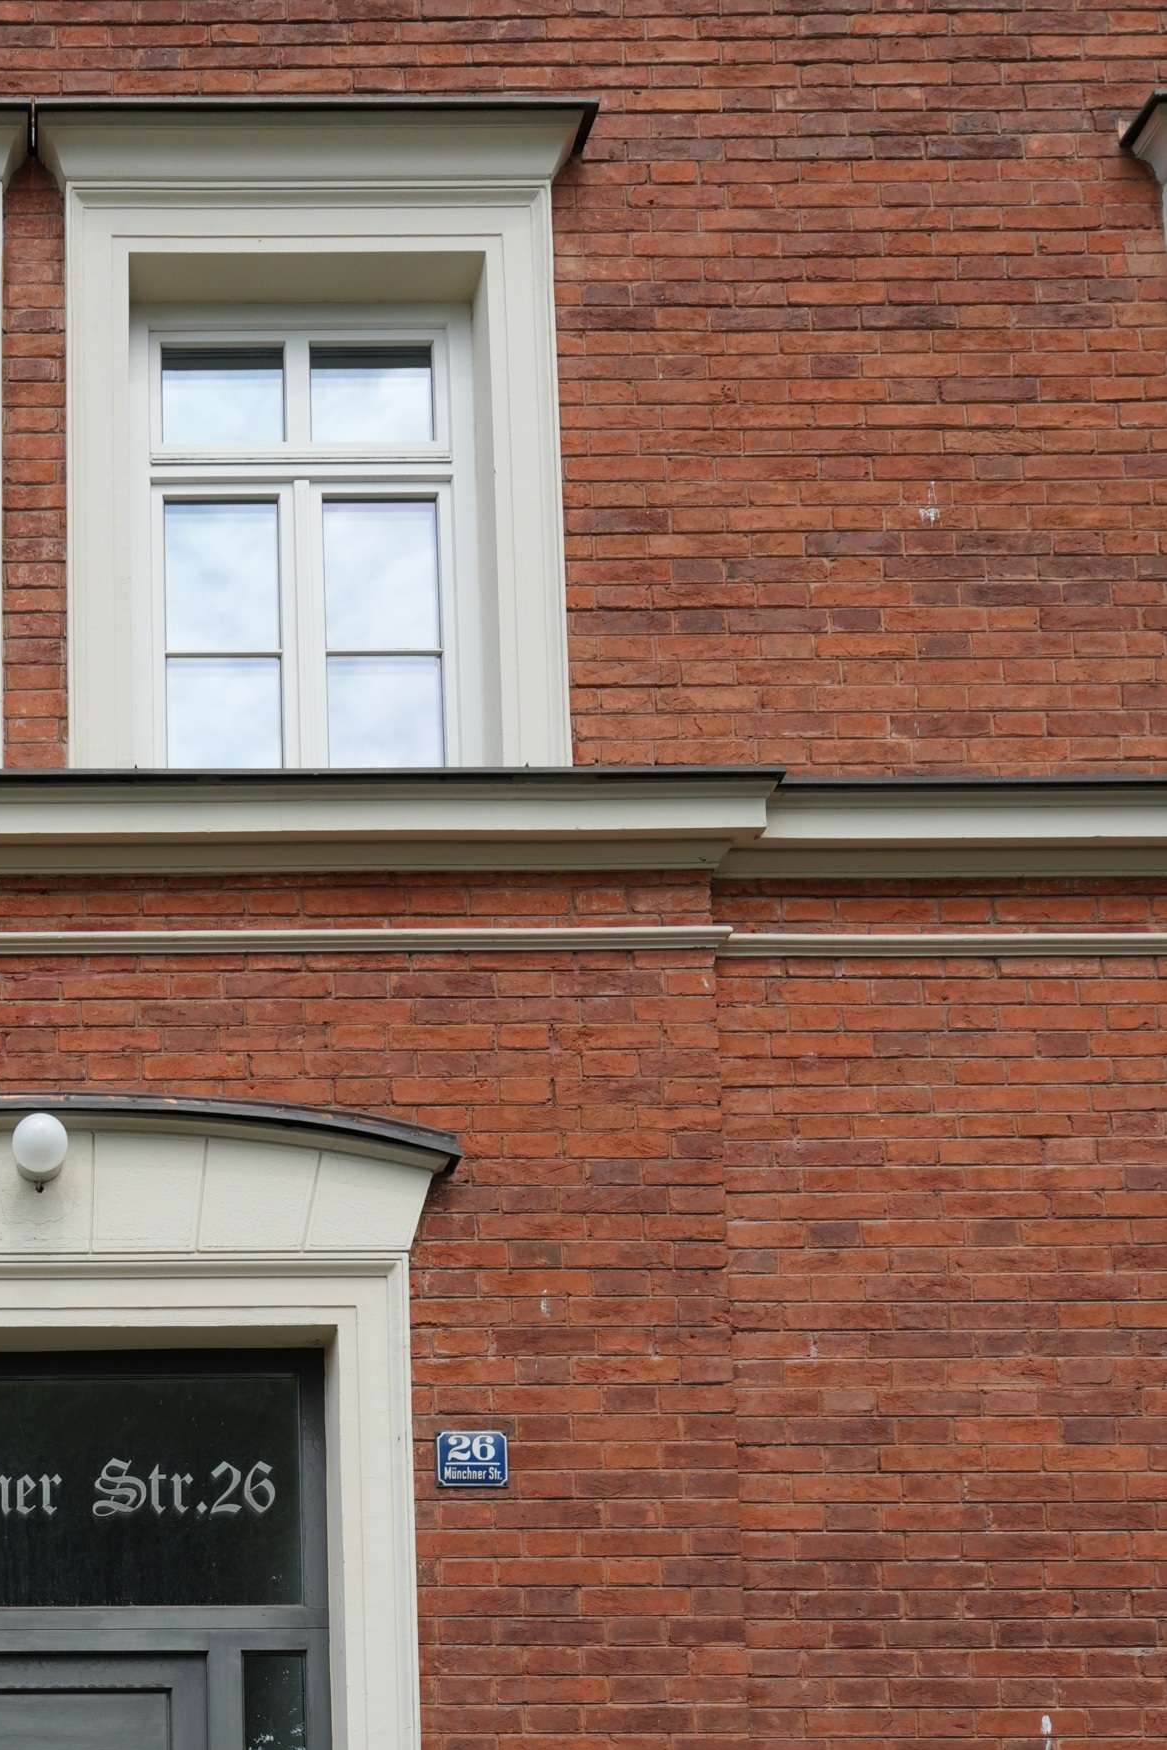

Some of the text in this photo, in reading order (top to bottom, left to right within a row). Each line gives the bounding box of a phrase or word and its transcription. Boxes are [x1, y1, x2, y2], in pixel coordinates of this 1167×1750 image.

[447, 1435, 496, 1461] 26
[444, 1466, 503, 1480] Münchner Str.
